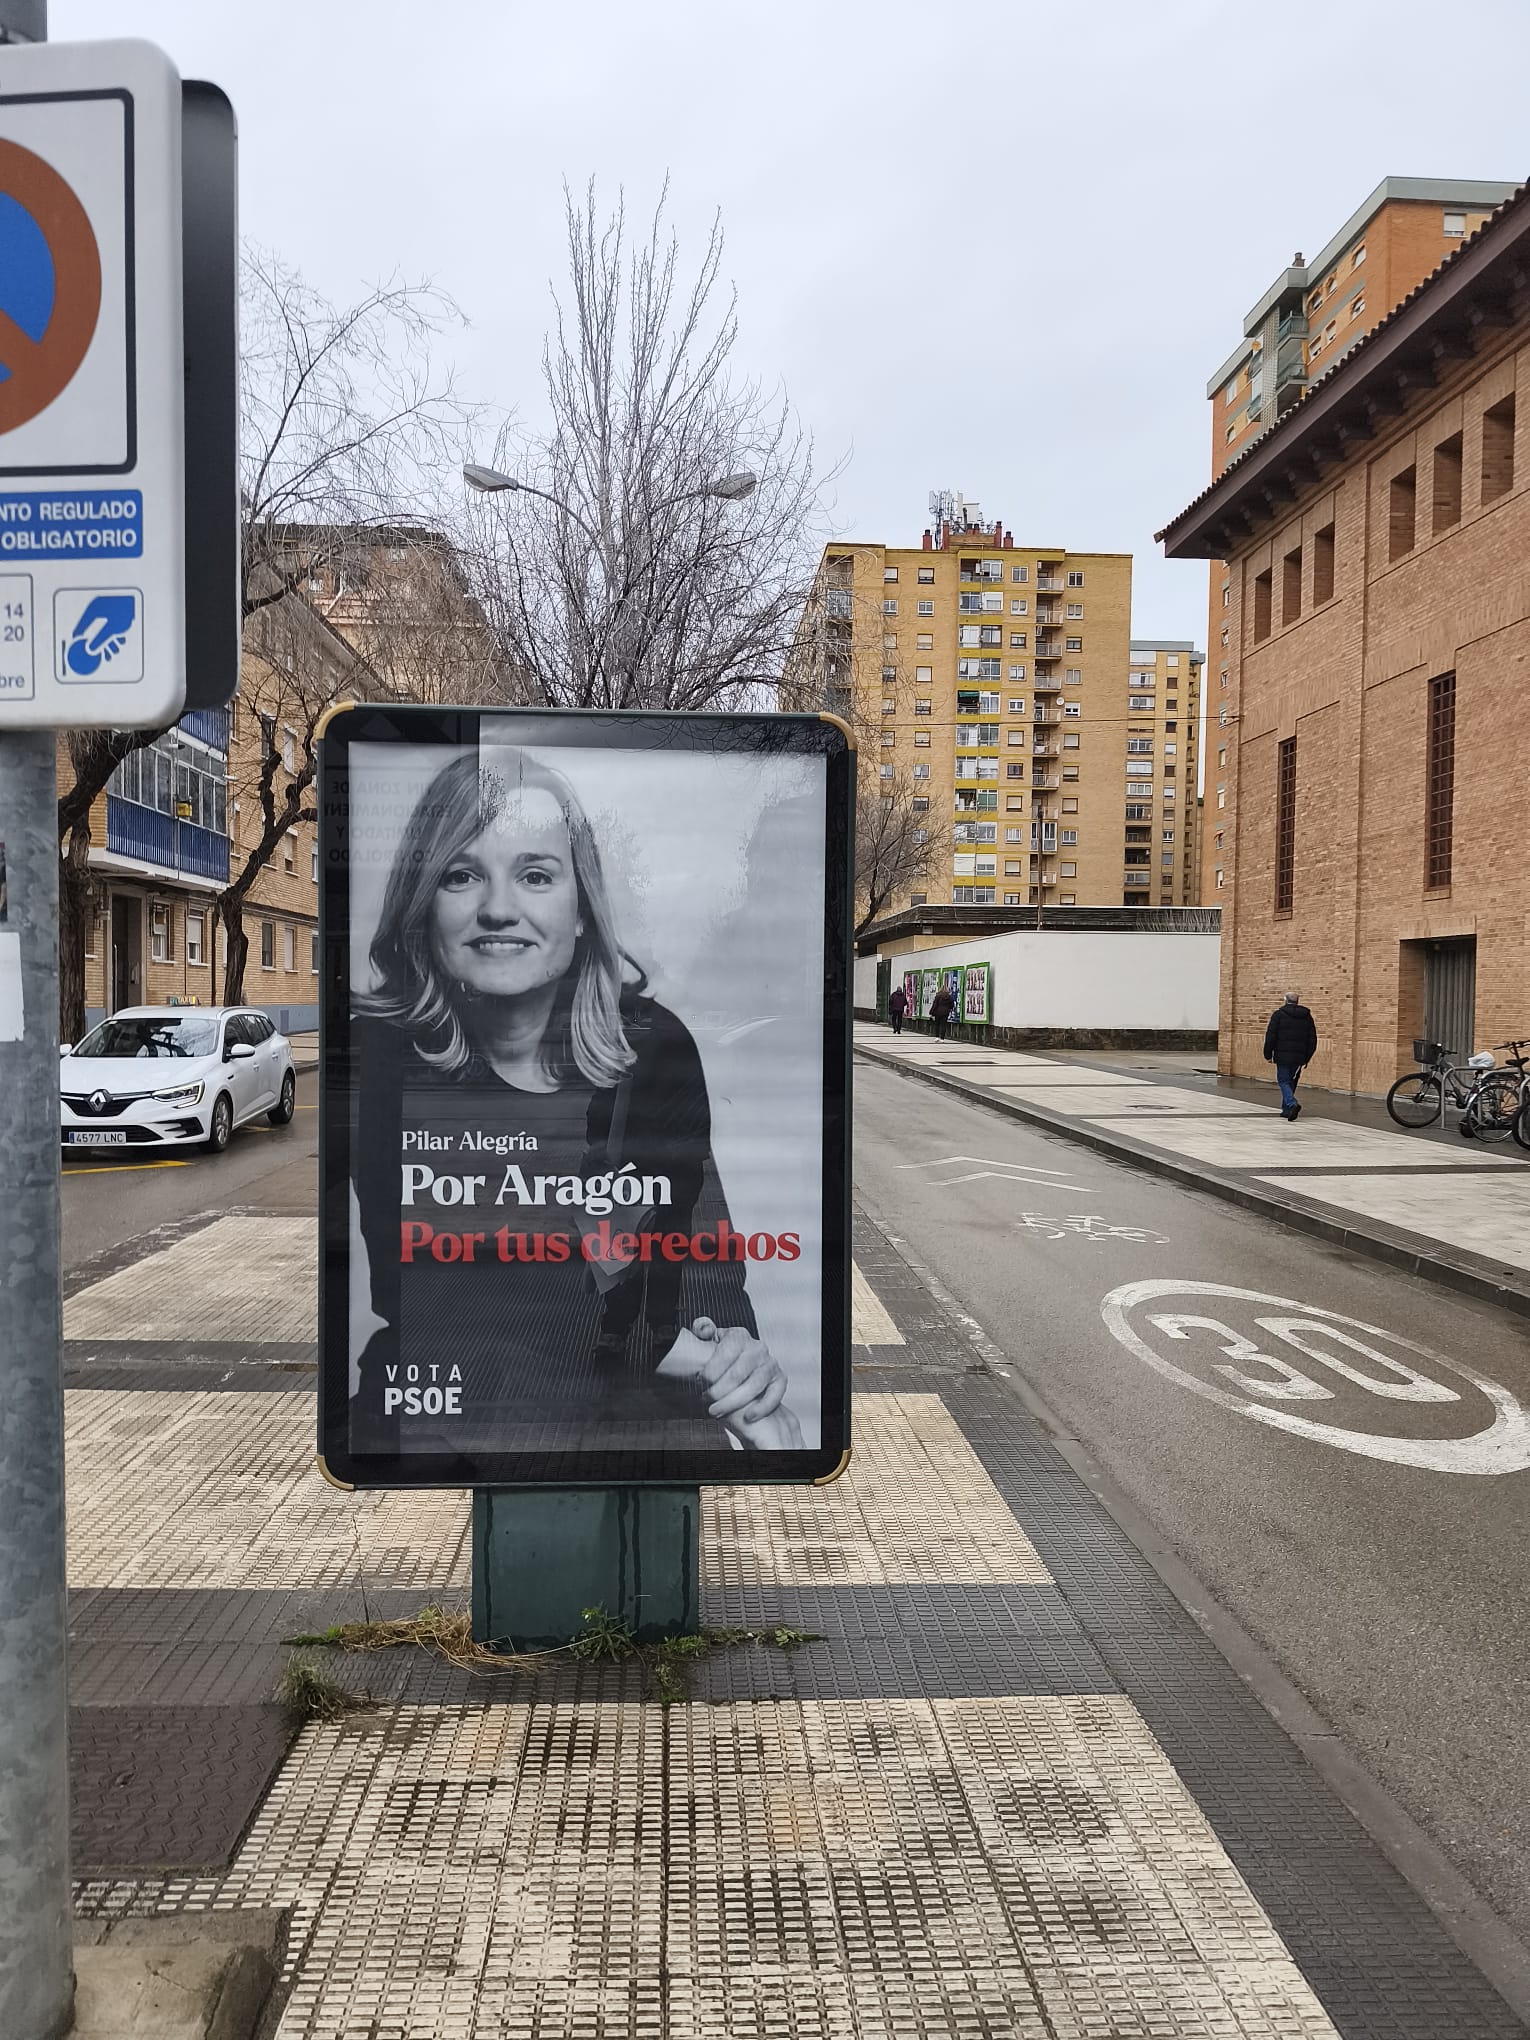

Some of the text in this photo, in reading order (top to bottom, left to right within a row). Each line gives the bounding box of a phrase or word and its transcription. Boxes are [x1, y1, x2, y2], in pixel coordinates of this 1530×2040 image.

[39, 500, 137, 520] REGULADO
[1, 528, 137, 550] OBLIGATORIO
[5, 602, 24, 619] 14
[4, 625, 25, 642] 20
[76, 1133, 123, 1143] 4577 LNC
[402, 1130, 539, 1155] Pilar Alegría
[401, 1161, 673, 1216] Por Aragón
[400, 1219, 801, 1263] Por tus derechos
[1143, 1312, 1462, 1403] 30
[385, 1364, 462, 1382] VOTA
[384, 1386, 463, 1415] PSOE
